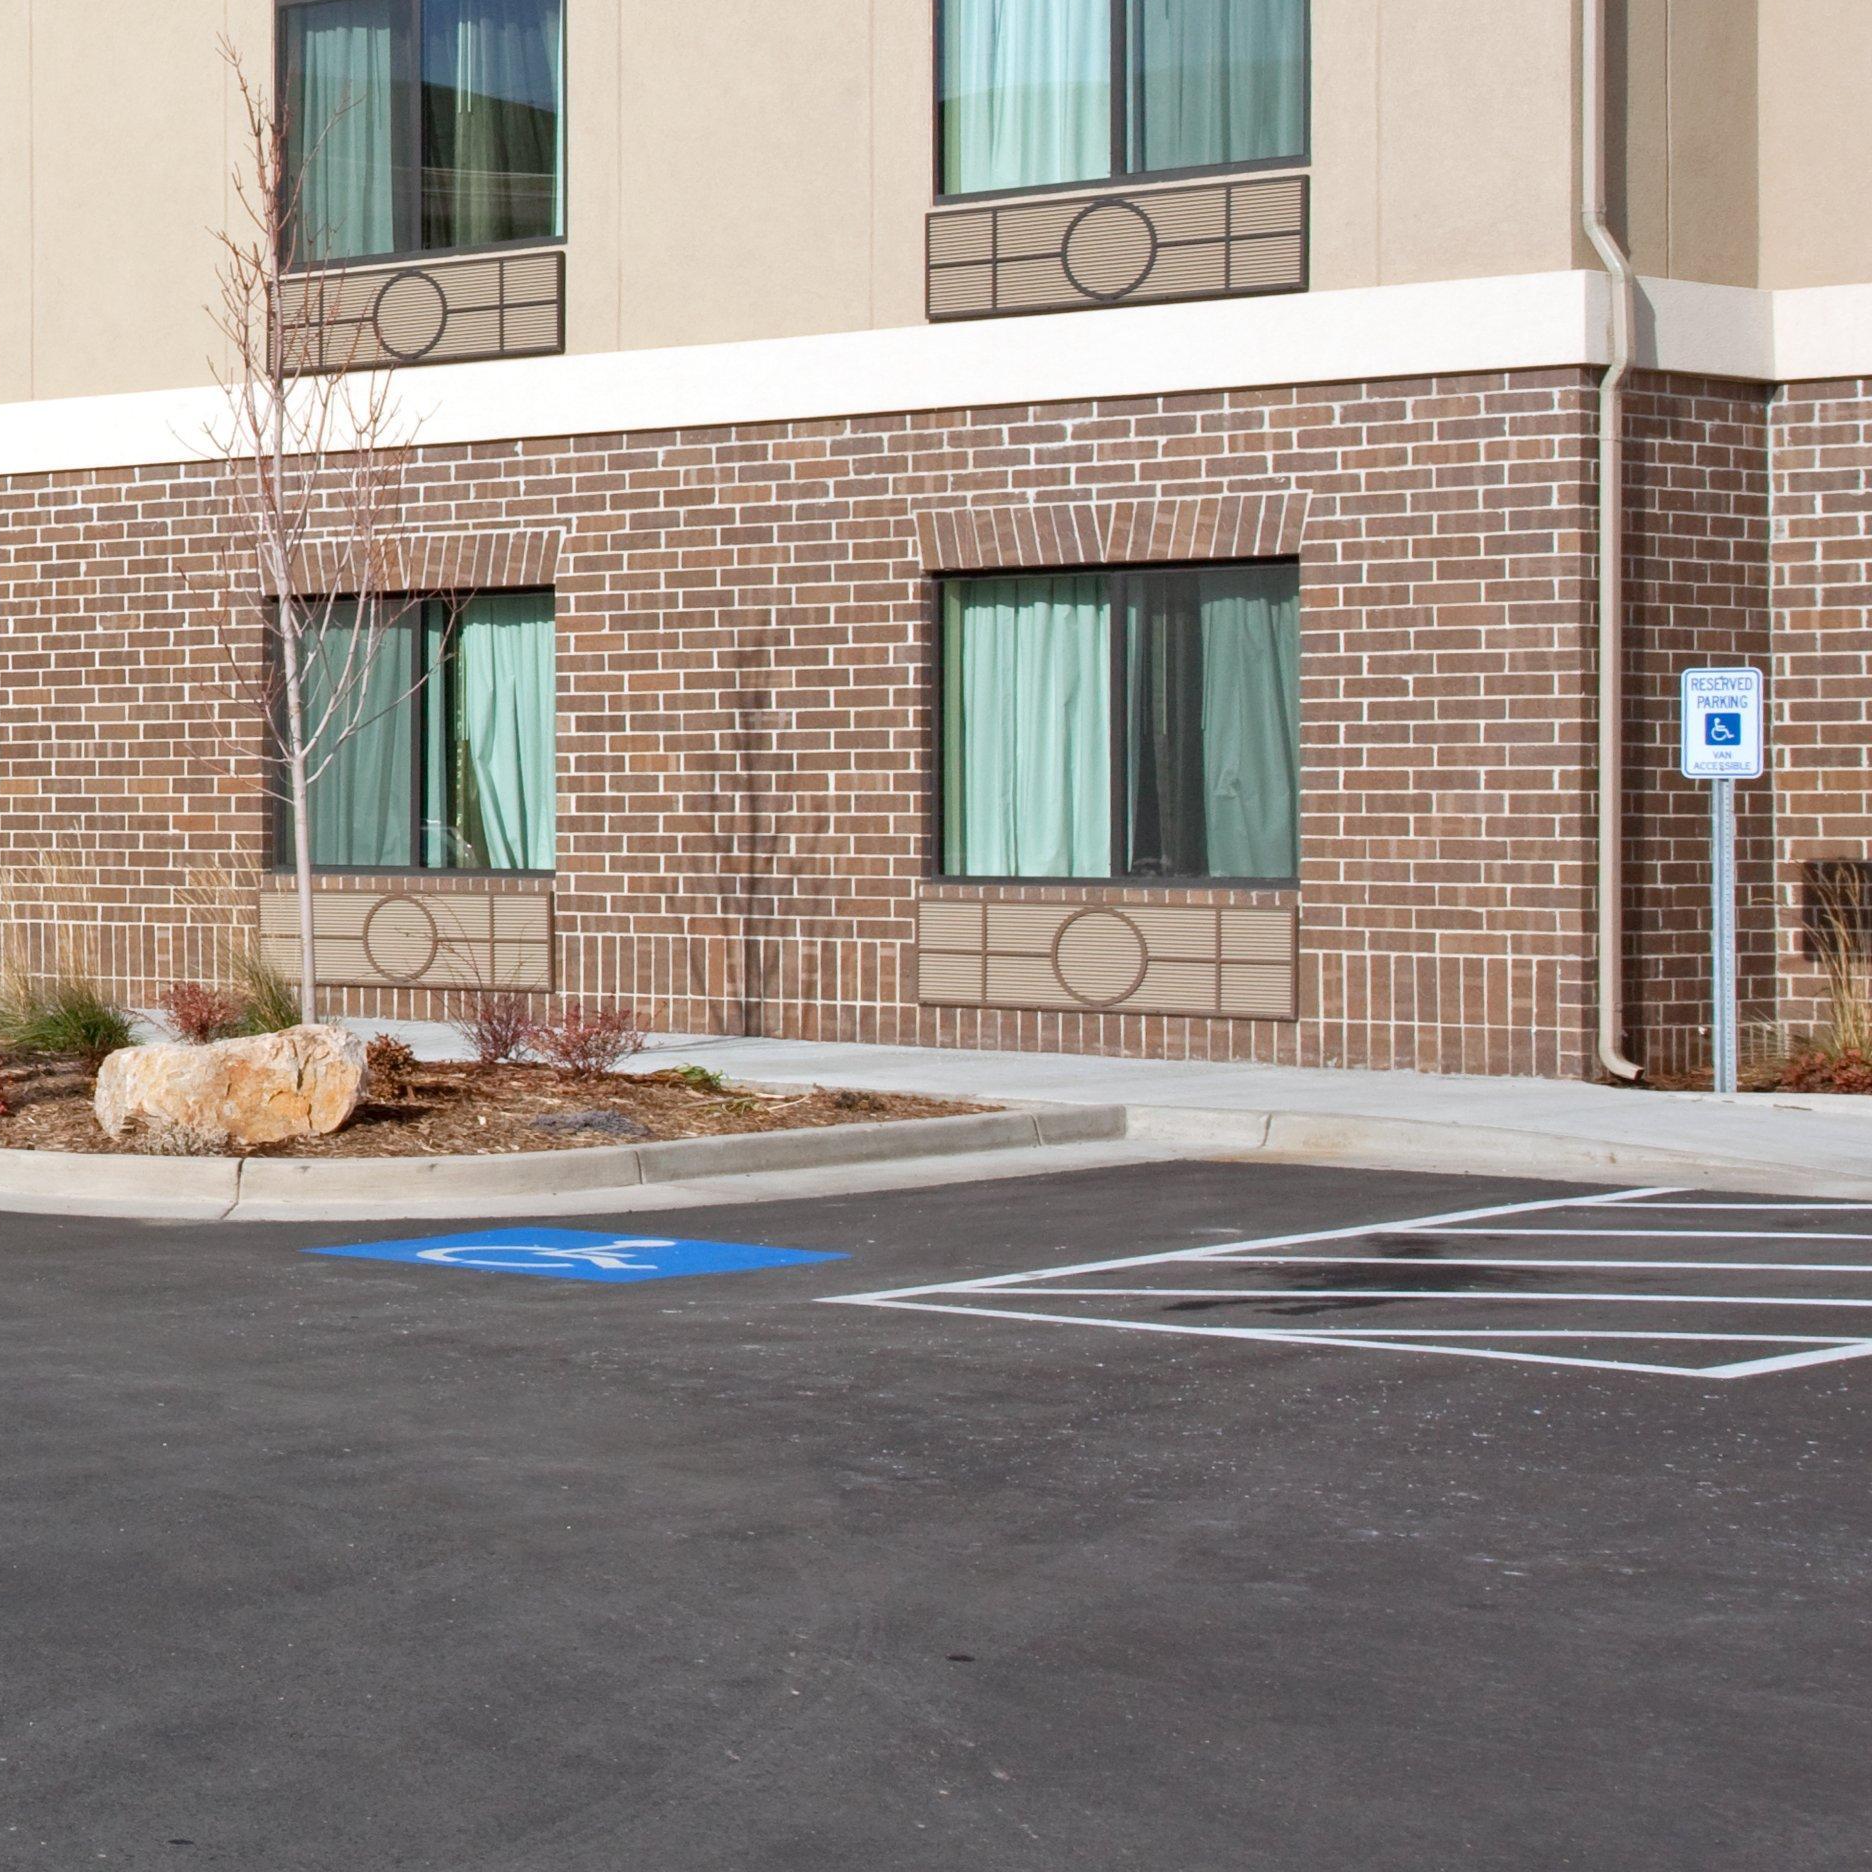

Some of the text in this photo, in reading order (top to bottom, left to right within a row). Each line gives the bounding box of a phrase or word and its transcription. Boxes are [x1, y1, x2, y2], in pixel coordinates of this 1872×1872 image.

[1691, 677, 1753, 691] RESERVED
[1697, 695, 1748, 709] PARKING
[1713, 750, 1732, 759] VAN
[1693, 762, 1751, 771] ACCESSIBLE
